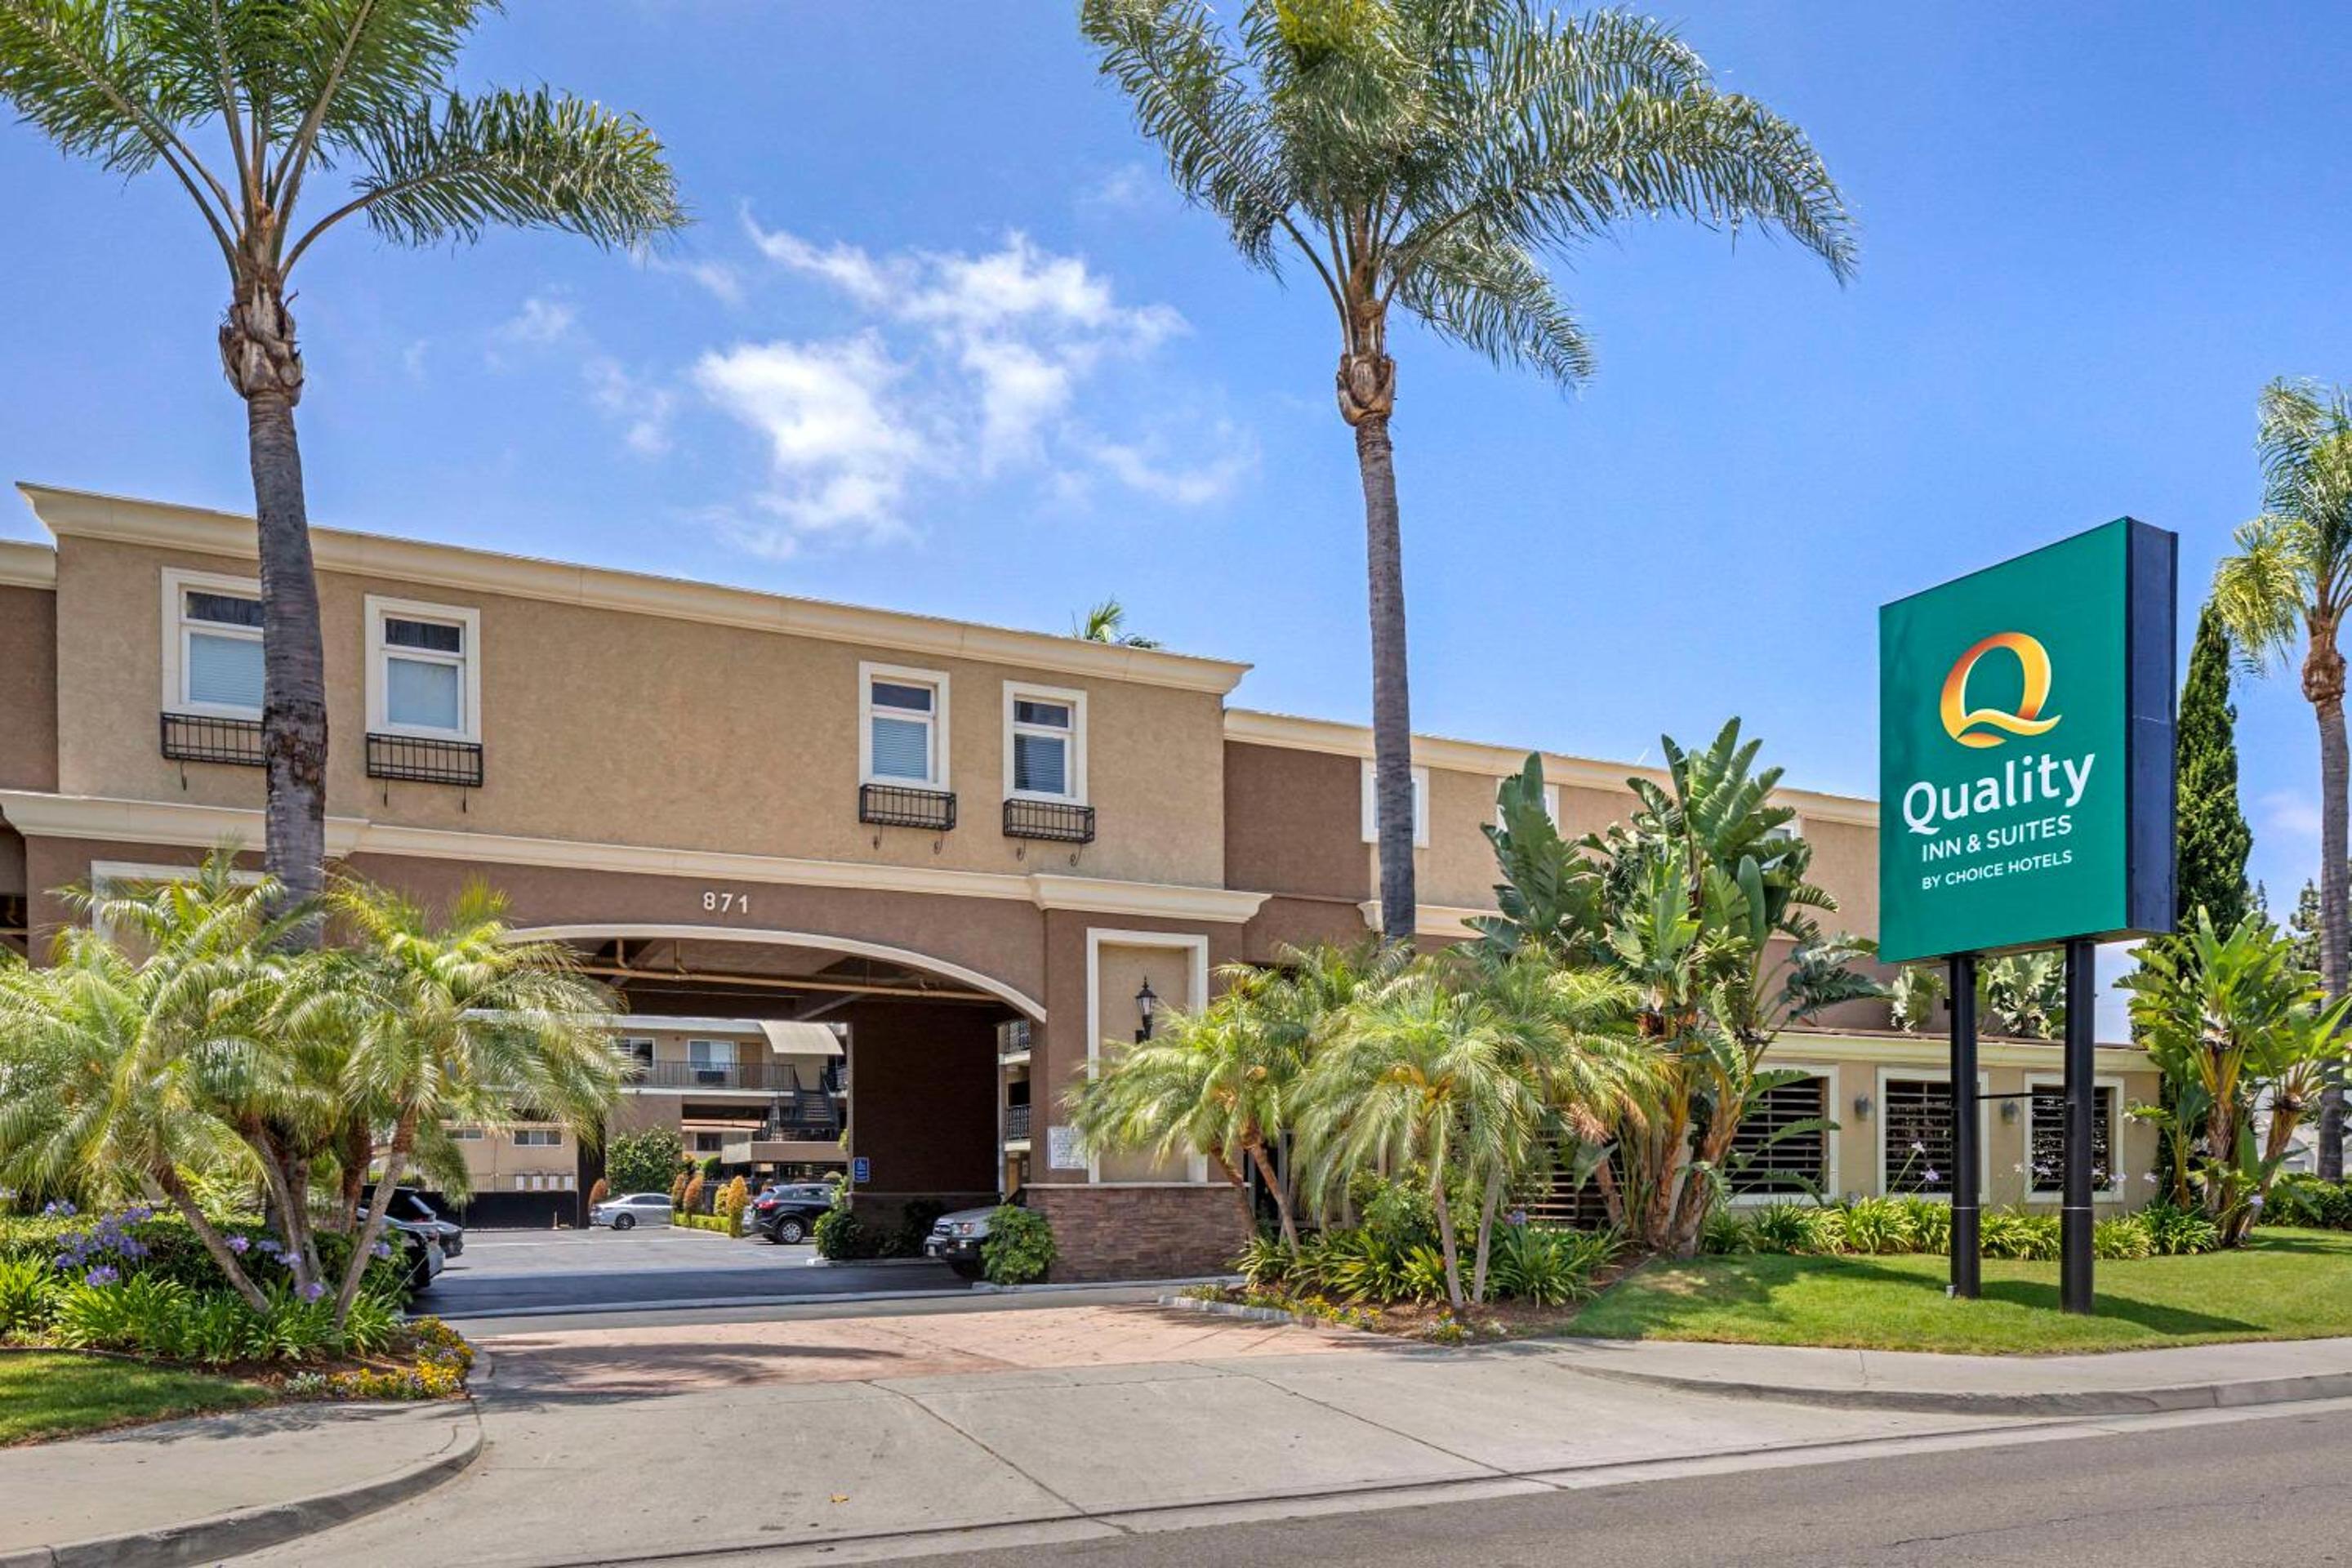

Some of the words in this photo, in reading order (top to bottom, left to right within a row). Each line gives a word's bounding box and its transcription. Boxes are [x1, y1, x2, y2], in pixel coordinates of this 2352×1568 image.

[1903, 753, 2096, 835] Quality
[1922, 837, 1961, 862] INN
[1966, 834, 1981, 853] &
[1986, 814, 2073, 849] SUITES
[1922, 875, 1942, 889] BY
[1944, 863, 2004, 885] CHOICE
[2007, 850, 2073, 874] HOTELS
[703, 891, 748, 914] 871
